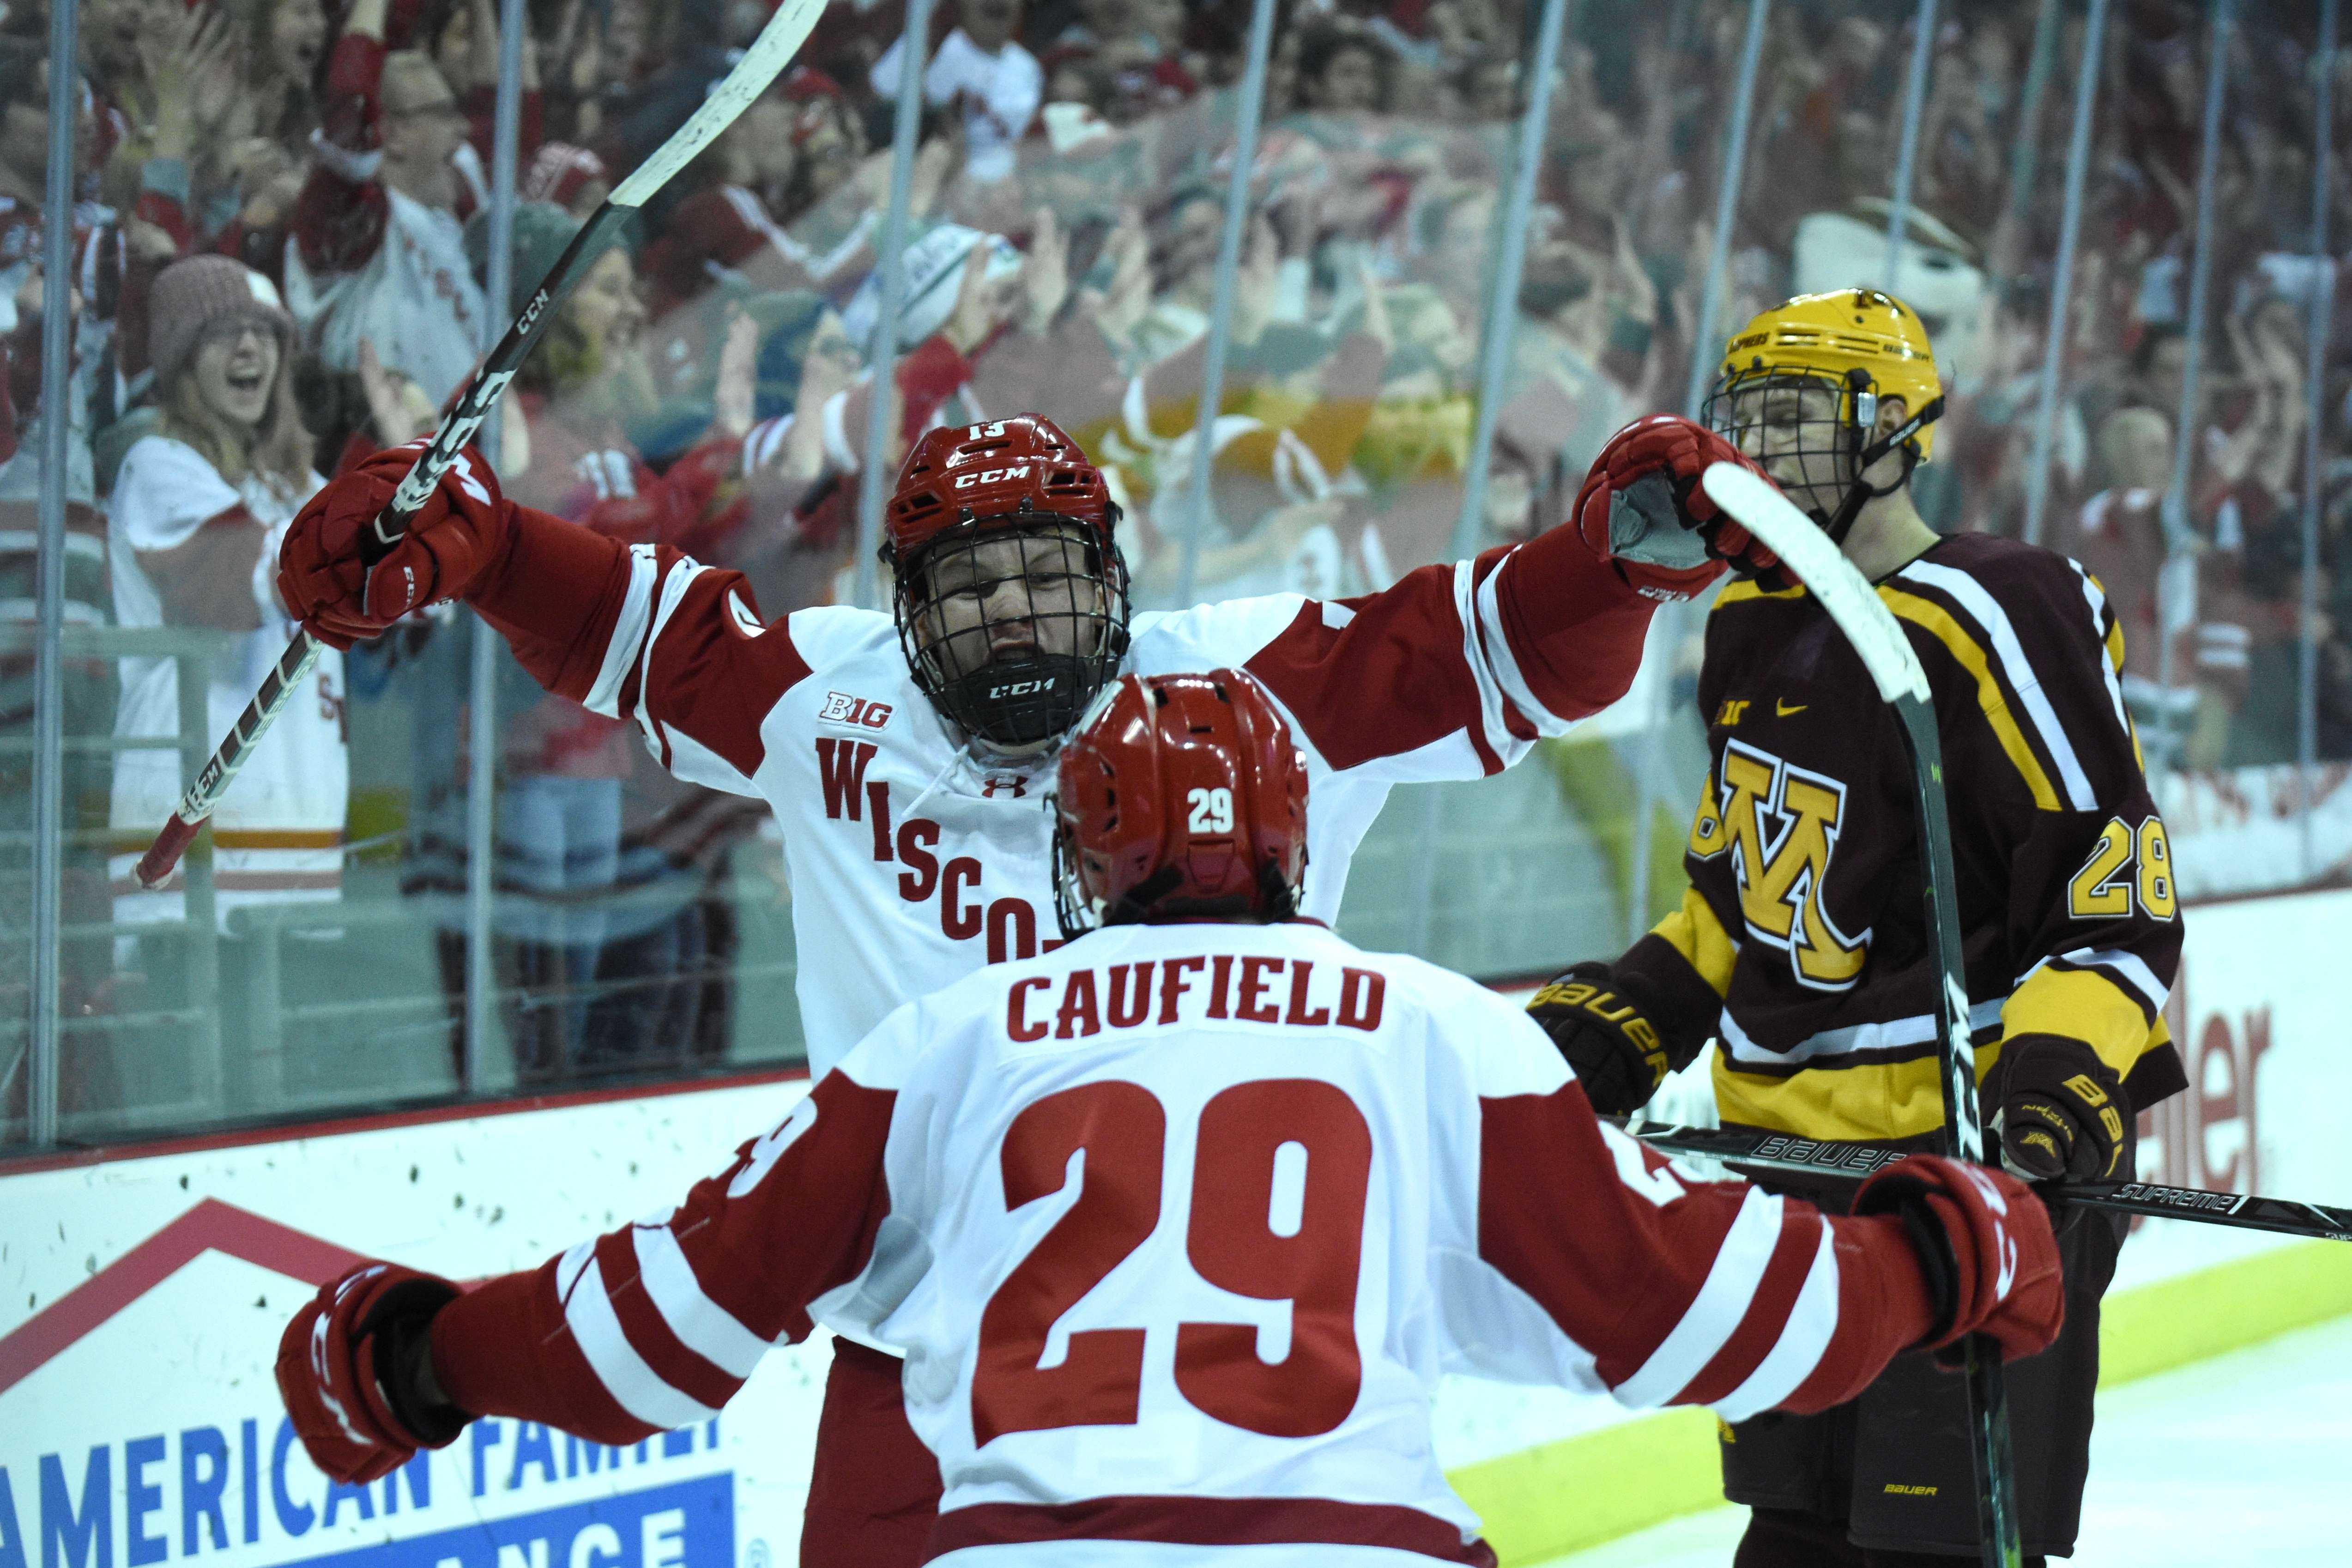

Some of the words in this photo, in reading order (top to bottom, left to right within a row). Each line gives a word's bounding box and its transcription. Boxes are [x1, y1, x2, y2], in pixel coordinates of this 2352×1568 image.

[517, 288, 548, 334] CCM
[969, 422, 1005, 441] 13
[955, 466, 1031, 489] CCM
[990, 677, 1055, 699] CCM
[1187, 787, 1234, 834] 29
[816, 737, 1065, 965] WISCO
[2068, 815, 2176, 922] 28
[1007, 955, 1386, 1043] CAUFIELD
[971, 1078, 1373, 1450] 29
